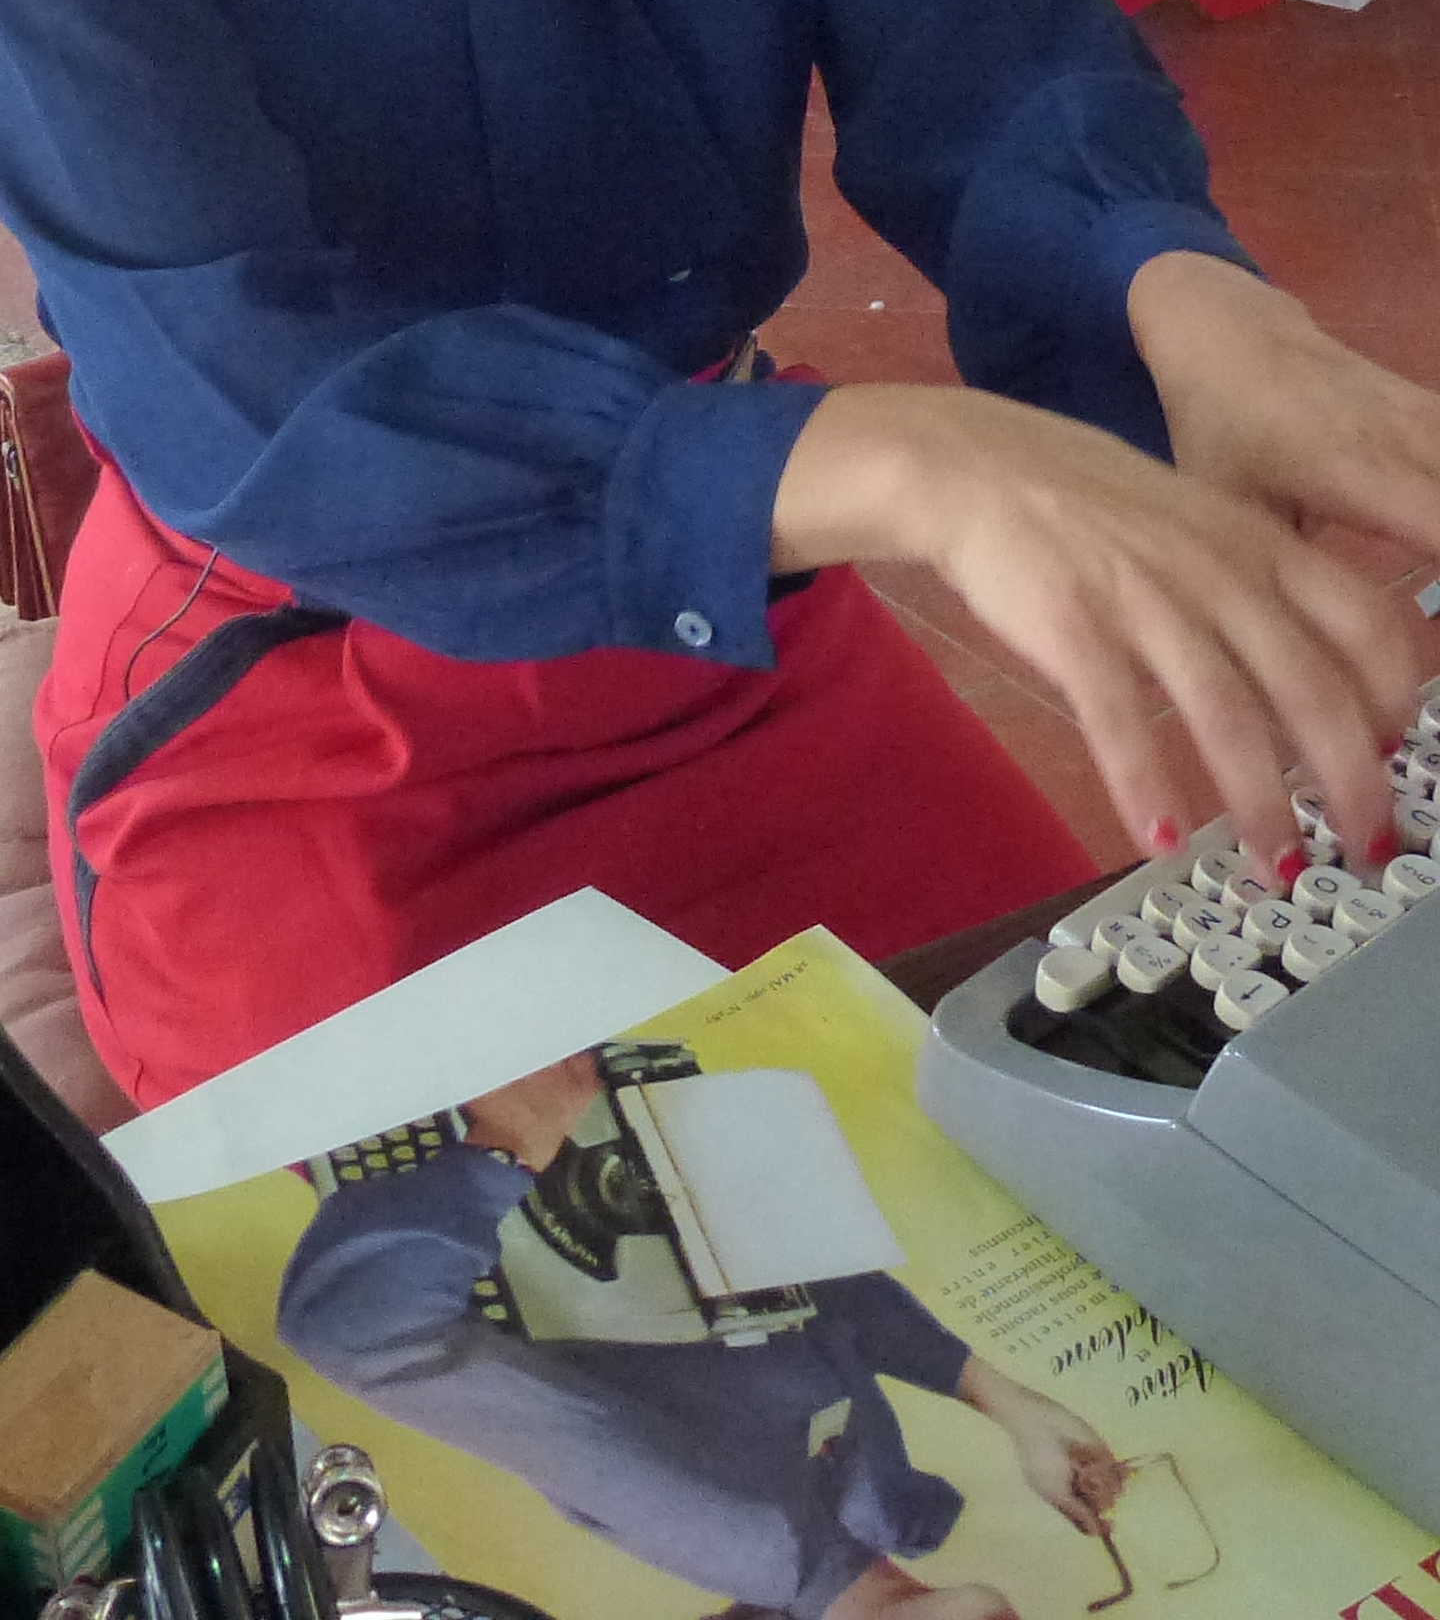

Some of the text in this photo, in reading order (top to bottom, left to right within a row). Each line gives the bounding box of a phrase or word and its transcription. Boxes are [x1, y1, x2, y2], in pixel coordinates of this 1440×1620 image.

[941, 1260, 998, 1296] entre
[956, 1294, 978, 1310] de
[989, 1278, 1088, 1339] nous raconte
[1134, 1347, 1152, 1363] et
[1124, 1346, 1215, 1409] Active
